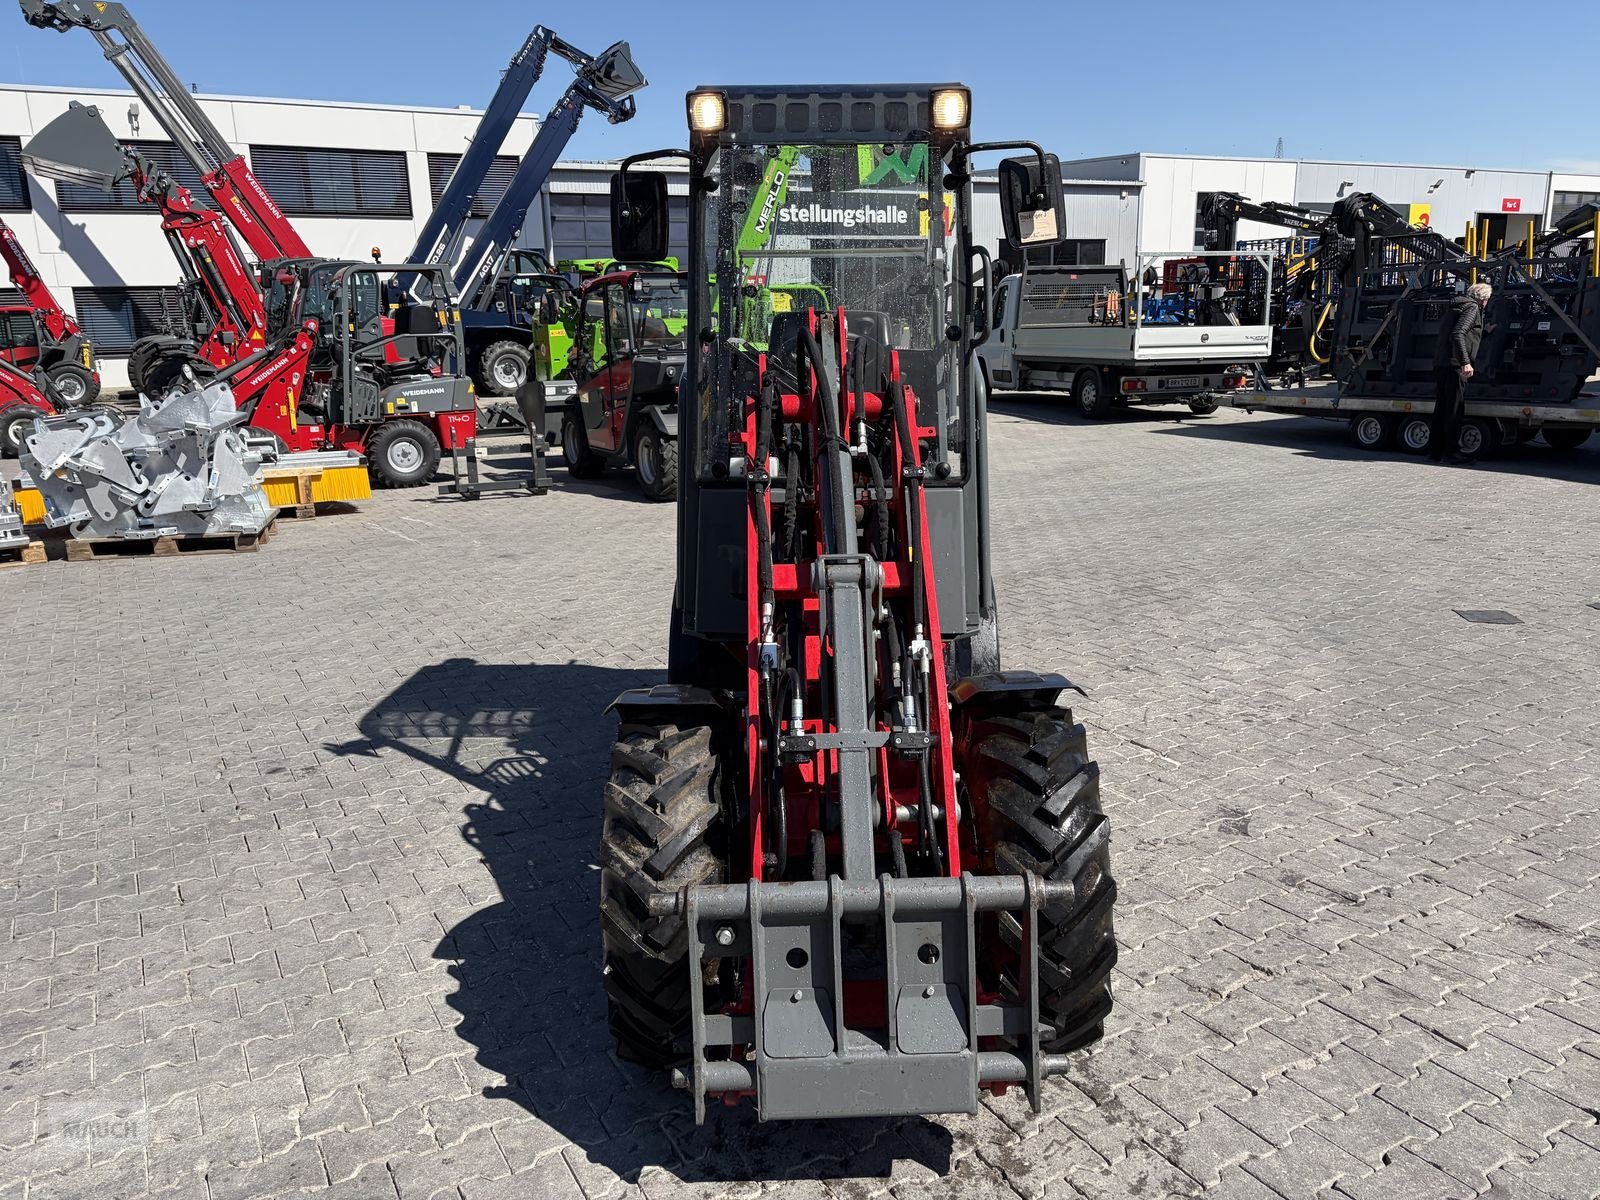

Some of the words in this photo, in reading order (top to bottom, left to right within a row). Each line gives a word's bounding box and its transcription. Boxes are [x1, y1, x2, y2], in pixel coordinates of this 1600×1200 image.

[245, 172, 282, 219] WEIDEMANN
[754, 170, 785, 233] MERLO
[771, 203, 908, 227] stellungshalle
[2, 230, 34, 277] WEIDEMANN
[479, 255, 494, 279] 40.17
[250, 357, 289, 386] WEIDEMANN
[401, 387, 445, 397] WEIDEMANN
[447, 415, 470, 423] 1140
